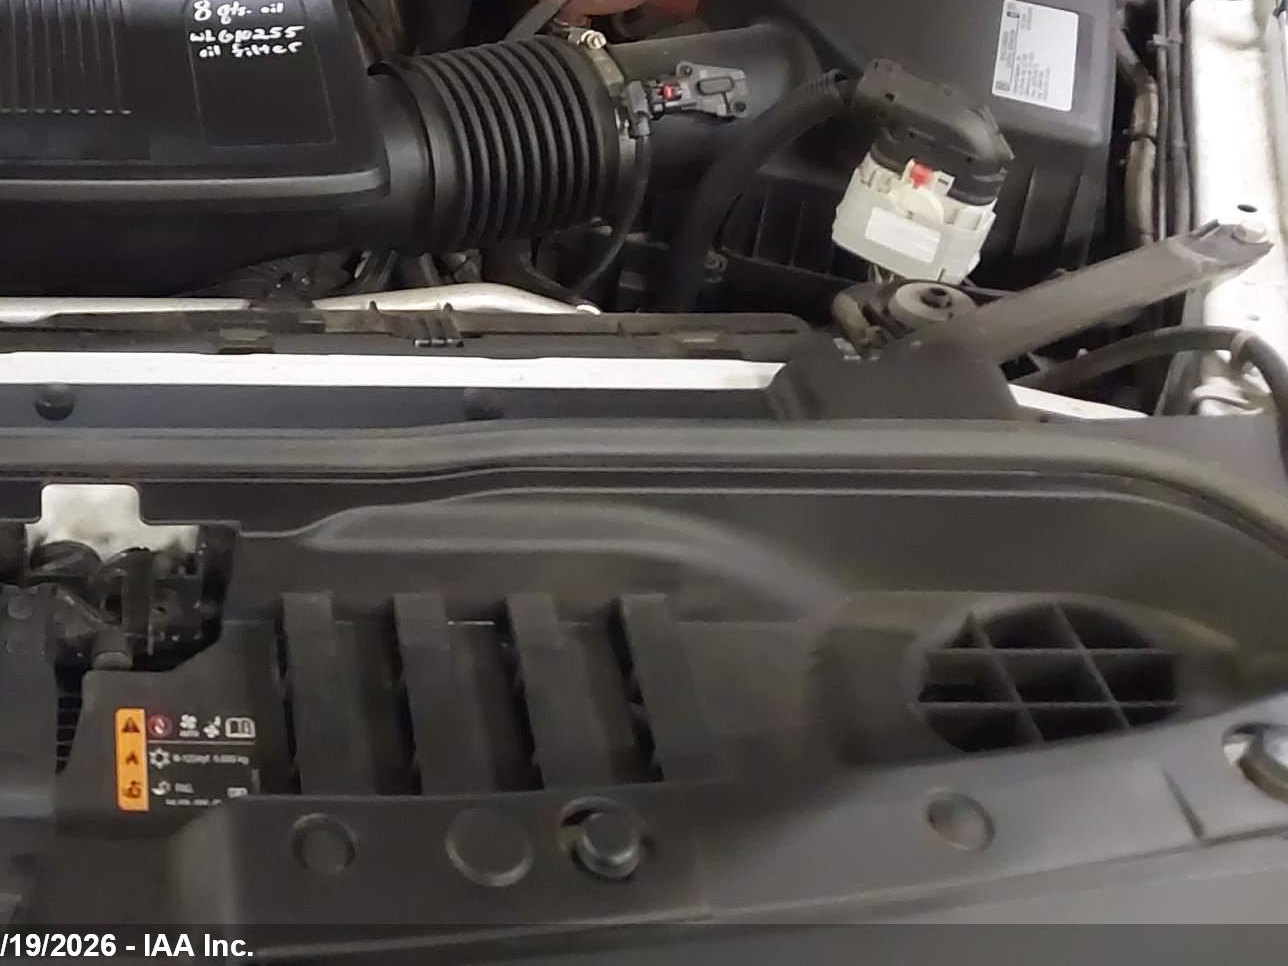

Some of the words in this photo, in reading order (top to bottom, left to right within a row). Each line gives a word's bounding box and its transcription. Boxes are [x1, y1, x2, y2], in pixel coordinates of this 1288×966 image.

[259, 1, 285, 15] oil
[198, 44, 222, 59] oil
[231, 41, 303, 58] filter
